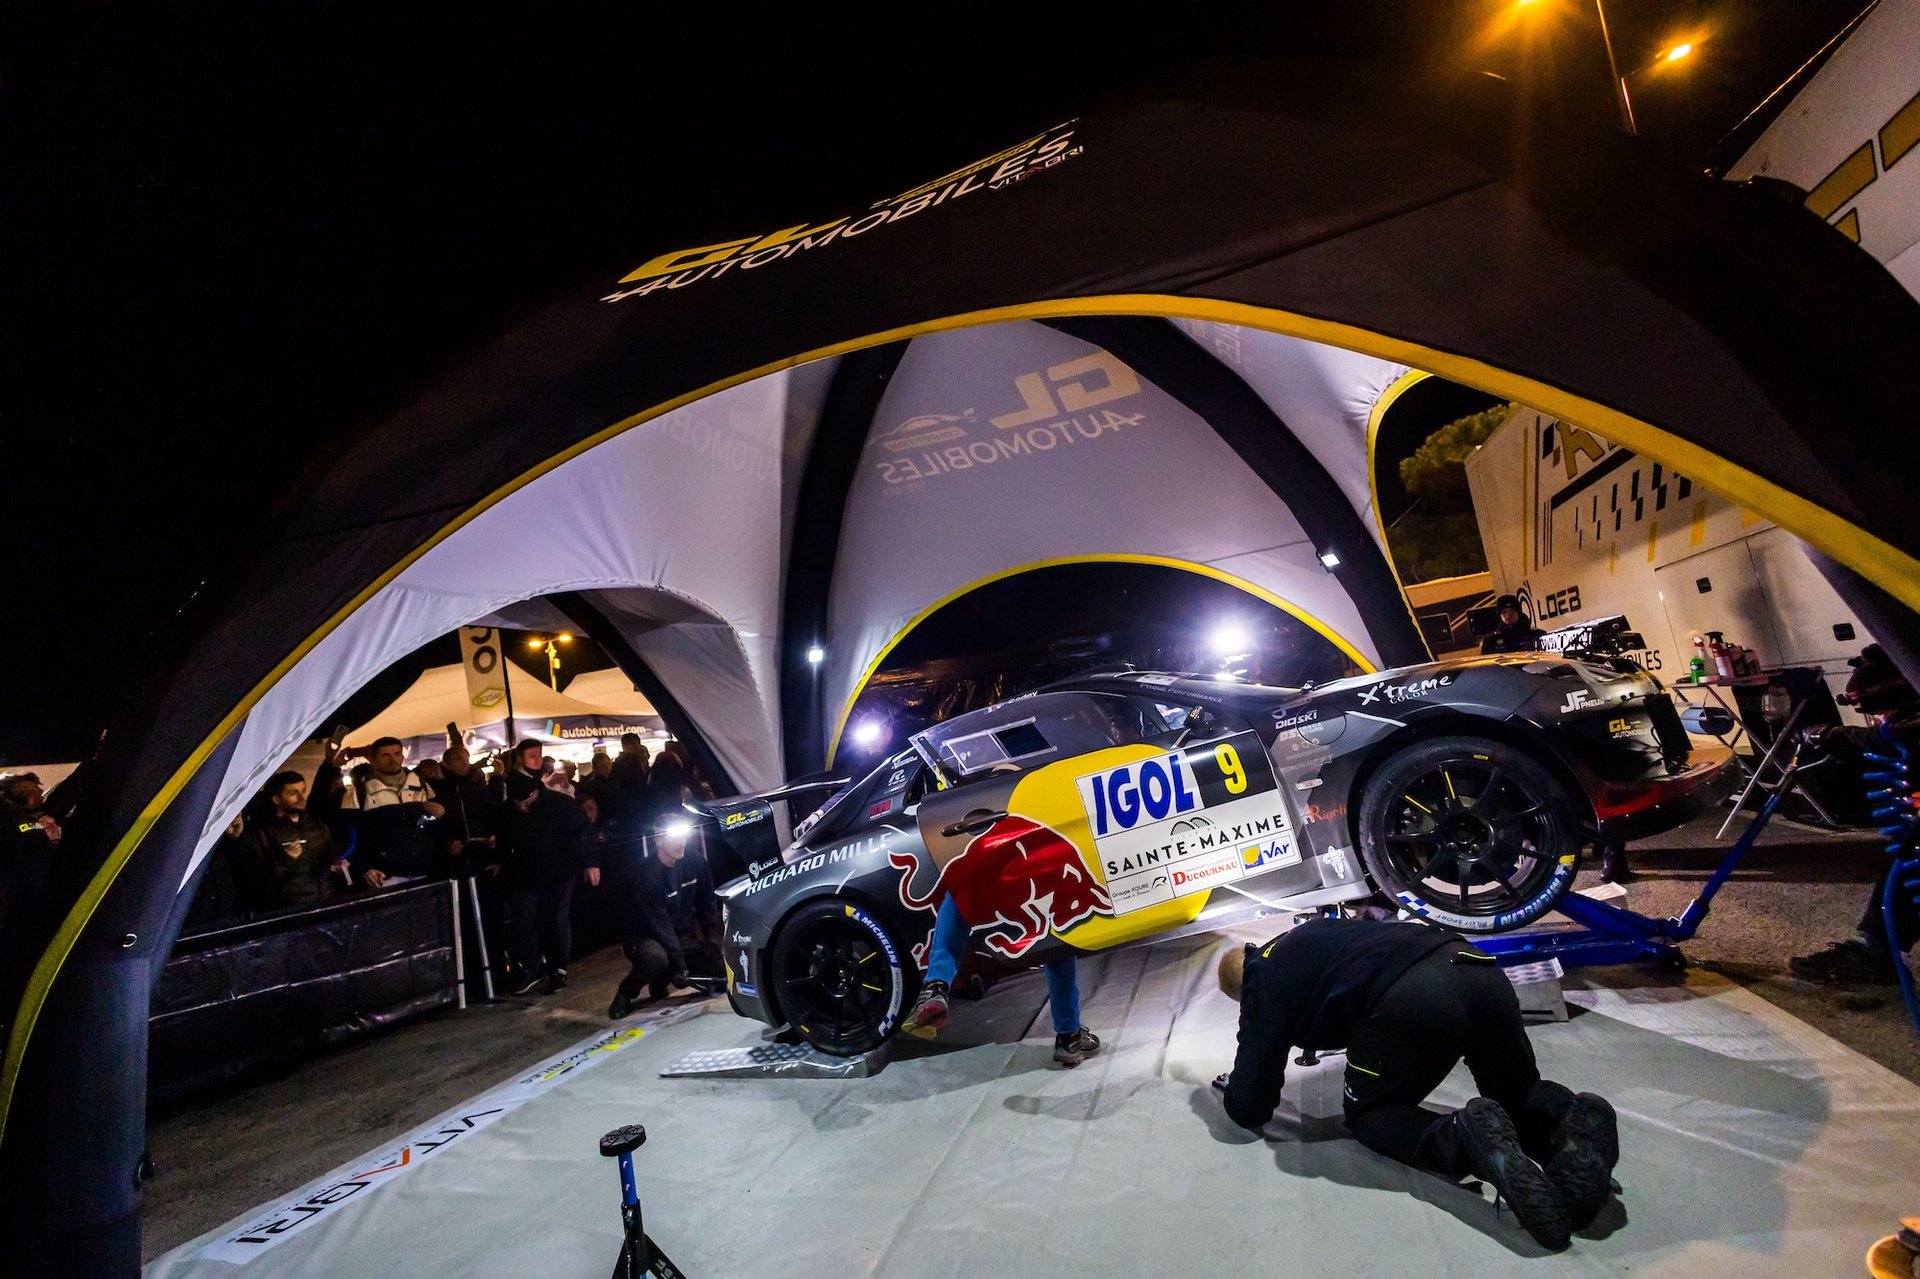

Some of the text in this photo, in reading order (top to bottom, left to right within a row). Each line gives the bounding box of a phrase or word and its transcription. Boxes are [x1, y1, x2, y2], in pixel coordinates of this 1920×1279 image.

[988, 146, 1083, 190] VITABRI
[600, 130, 1075, 304] AUTOMOBILES
[1538, 585, 1582, 621] LOEB
[1389, 689, 1429, 705] COLOR
[1560, 689, 1589, 713] JF
[561, 724, 647, 739] autobernard.com
[1608, 718, 1632, 733] GL
[1214, 743, 1248, 795] 9
[1091, 754, 1195, 836] IGOL
[726, 811, 746, 826] GL
[745, 831, 892, 897] RICHARD MILLE
[1107, 813, 1286, 876] SAINTE-MAXIME
[1111, 886, 1131, 899] Groupe
[1500, 878, 1562, 927] MICHELIN
[860, 916, 898, 965] MICHELIN
[235, 1107, 504, 1244] VITABRI
